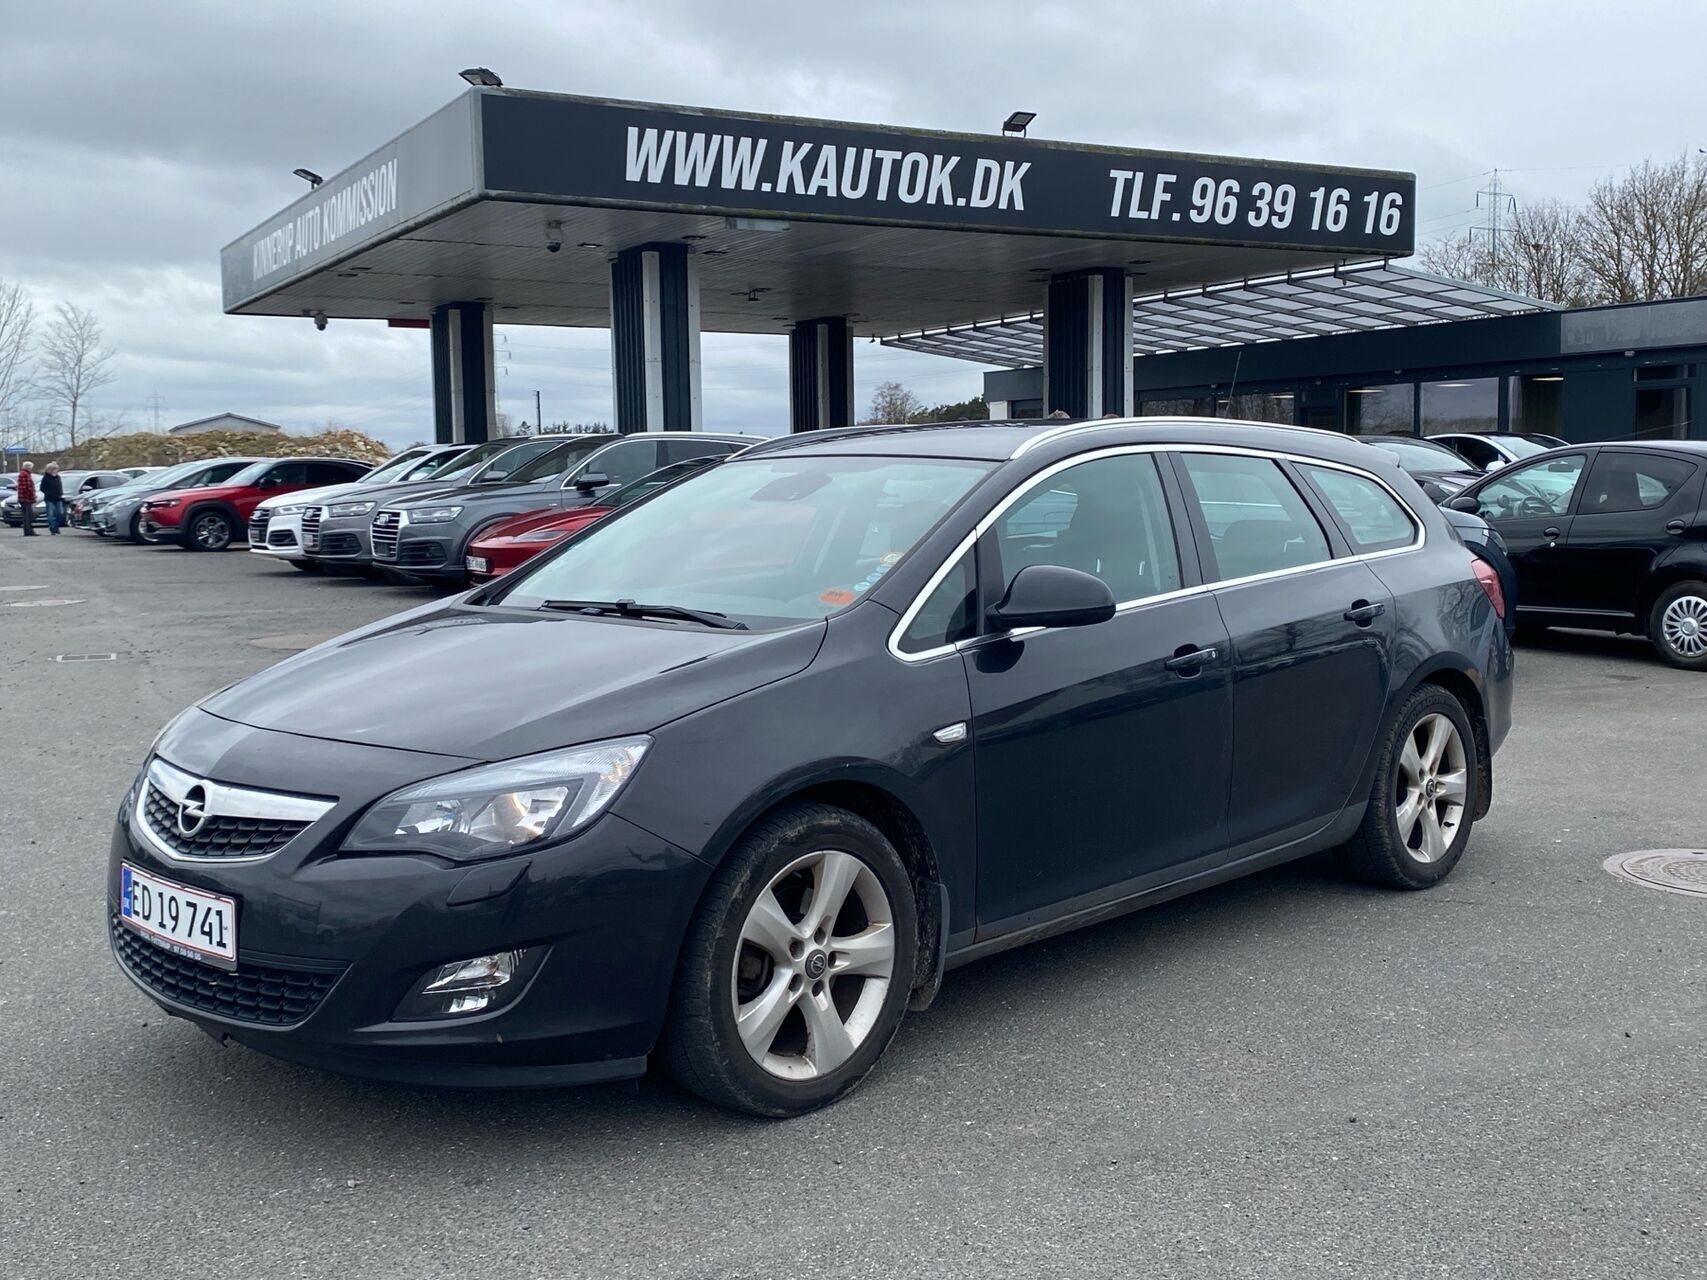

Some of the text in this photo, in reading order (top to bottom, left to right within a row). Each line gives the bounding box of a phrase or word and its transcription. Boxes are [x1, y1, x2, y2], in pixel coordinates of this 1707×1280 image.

[625, 126, 1032, 211] WWW.KAUTOK.DK
[1109, 169, 1403, 236] TLF. 96 39 16 16
[295, 206, 321, 260] AUTO
[322, 158, 398, 246] KOMMISSION
[132, 879, 152, 921] ED
[158, 891, 180, 934] 19
[185, 900, 227, 949] 741
